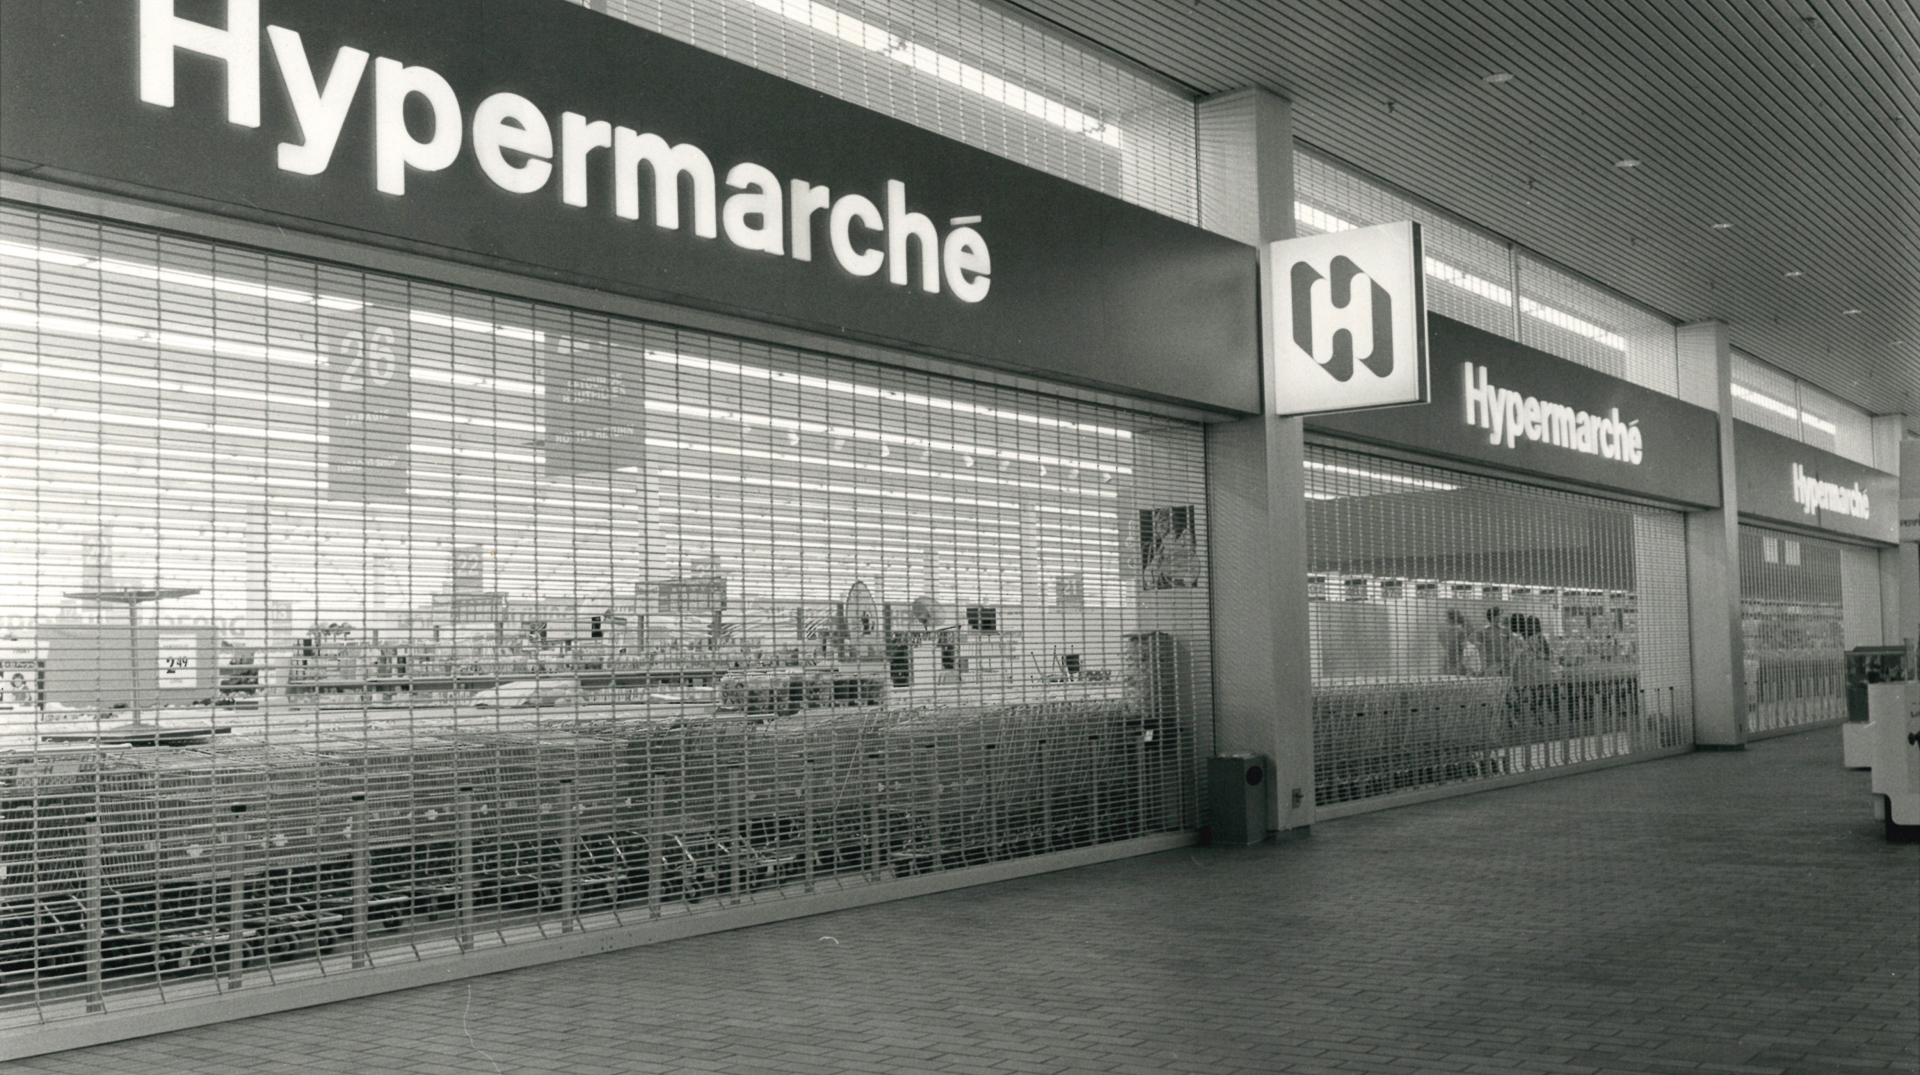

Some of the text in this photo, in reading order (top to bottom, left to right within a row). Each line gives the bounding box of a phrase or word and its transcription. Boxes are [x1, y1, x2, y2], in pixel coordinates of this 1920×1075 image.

[139, 0, 992, 303] Hypermarché
[340, 326, 395, 391] 26
[1462, 362, 1643, 465] Hypermarché
[1791, 463, 1870, 520] Hypermarché
[457, 554, 479, 576] 22
